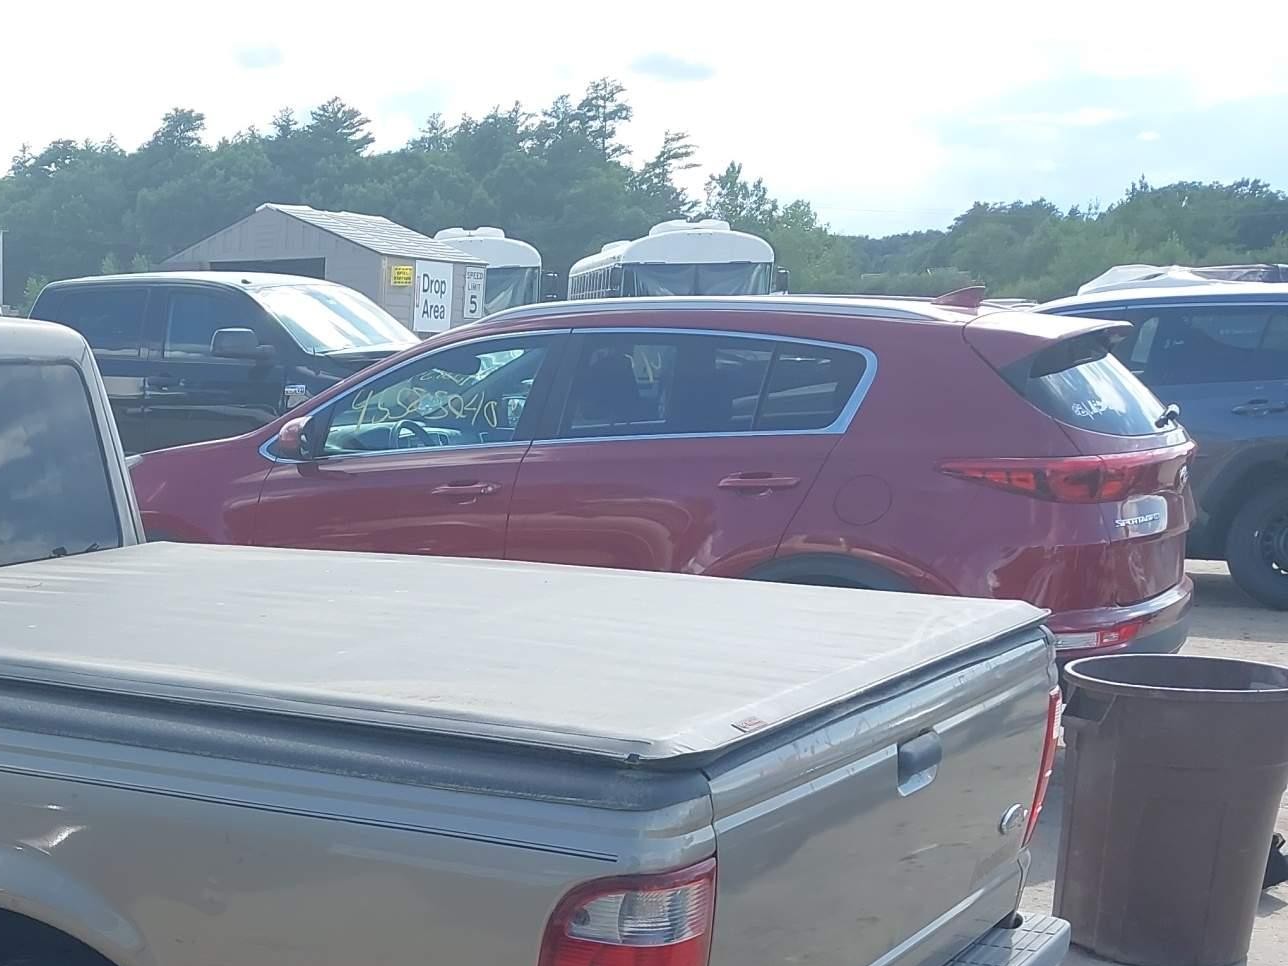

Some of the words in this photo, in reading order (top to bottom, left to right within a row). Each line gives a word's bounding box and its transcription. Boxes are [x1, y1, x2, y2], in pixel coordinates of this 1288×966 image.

[422, 273, 447, 298] Drop
[421, 299, 446, 320] Area
[469, 294, 478, 314] 5
